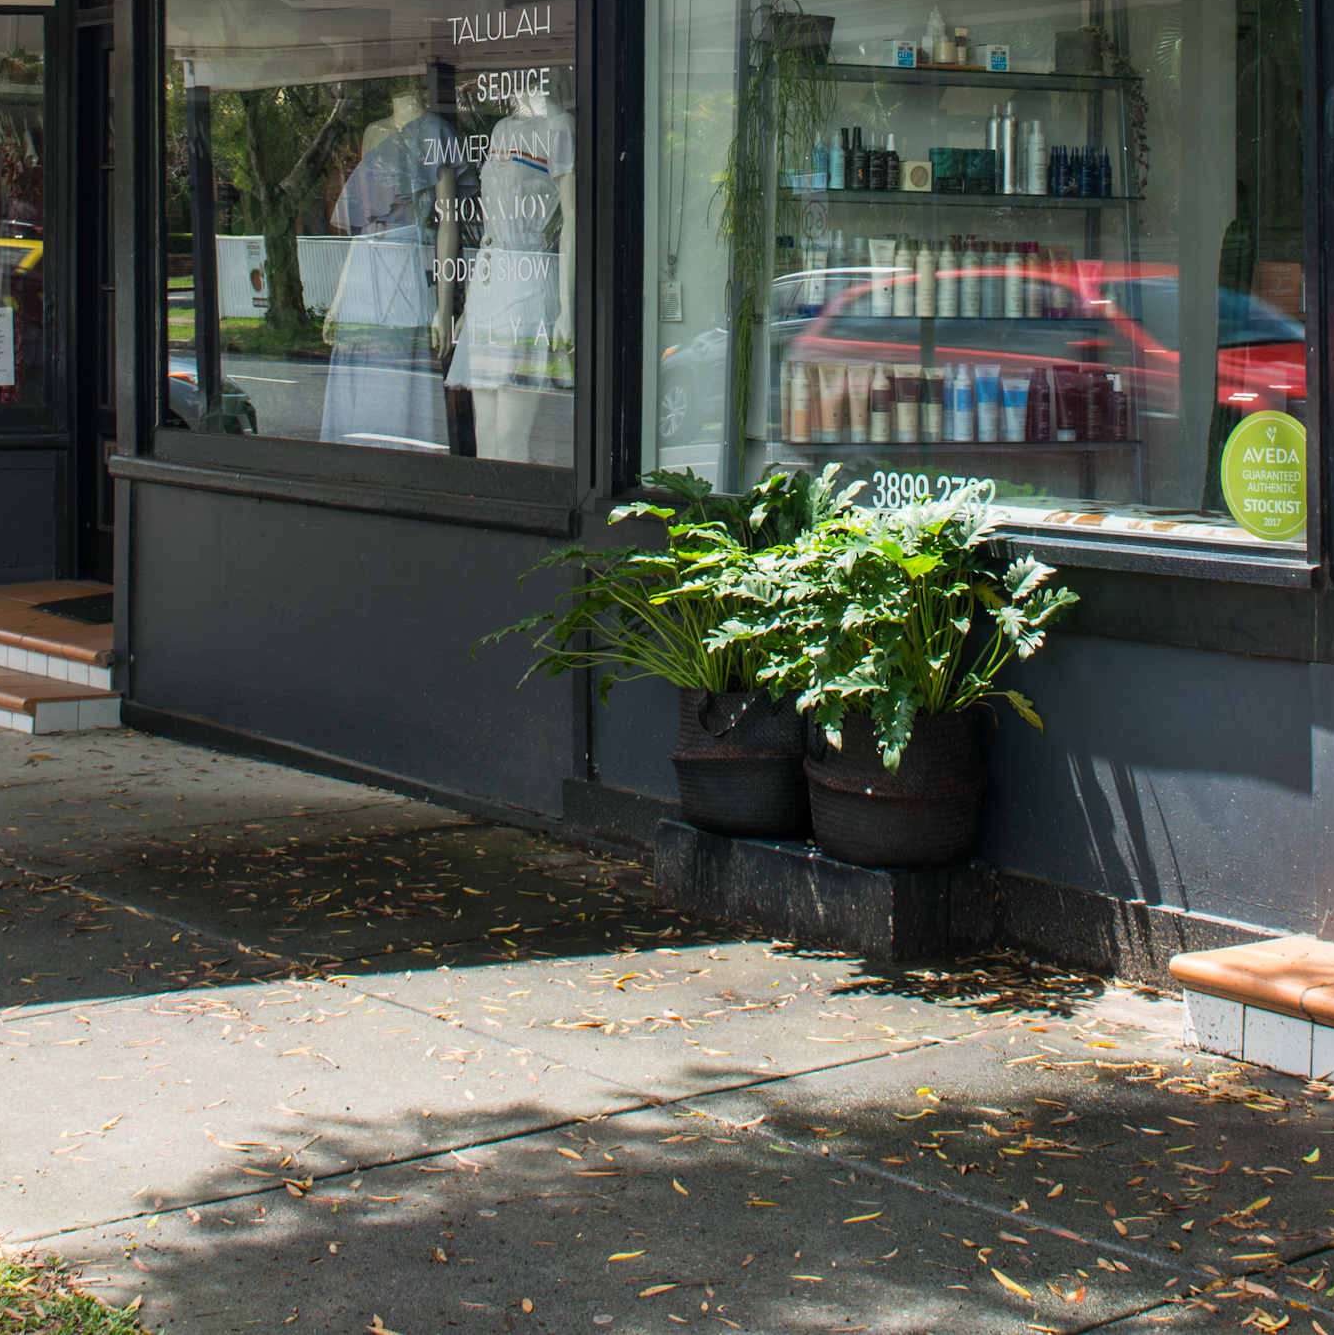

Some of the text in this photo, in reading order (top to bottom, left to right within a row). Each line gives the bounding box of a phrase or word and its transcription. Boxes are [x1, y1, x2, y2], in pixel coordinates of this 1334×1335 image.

[447, 5, 550, 45] TALULAH
[477, 67, 550, 102] SEDUCE
[423, 130, 550, 165] ZIMMERMANN
[433, 257, 550, 282] RODEO SHOW
[1242, 447, 1300, 464] AVEDA
[1241, 469, 1301, 482] GUARANTEED
[872, 470, 929, 509] 3899
[1247, 482, 1297, 494] AUTHENTIC
[1243, 498, 1301, 514] STOCKIST
[1263, 517, 1281, 527] 2017
